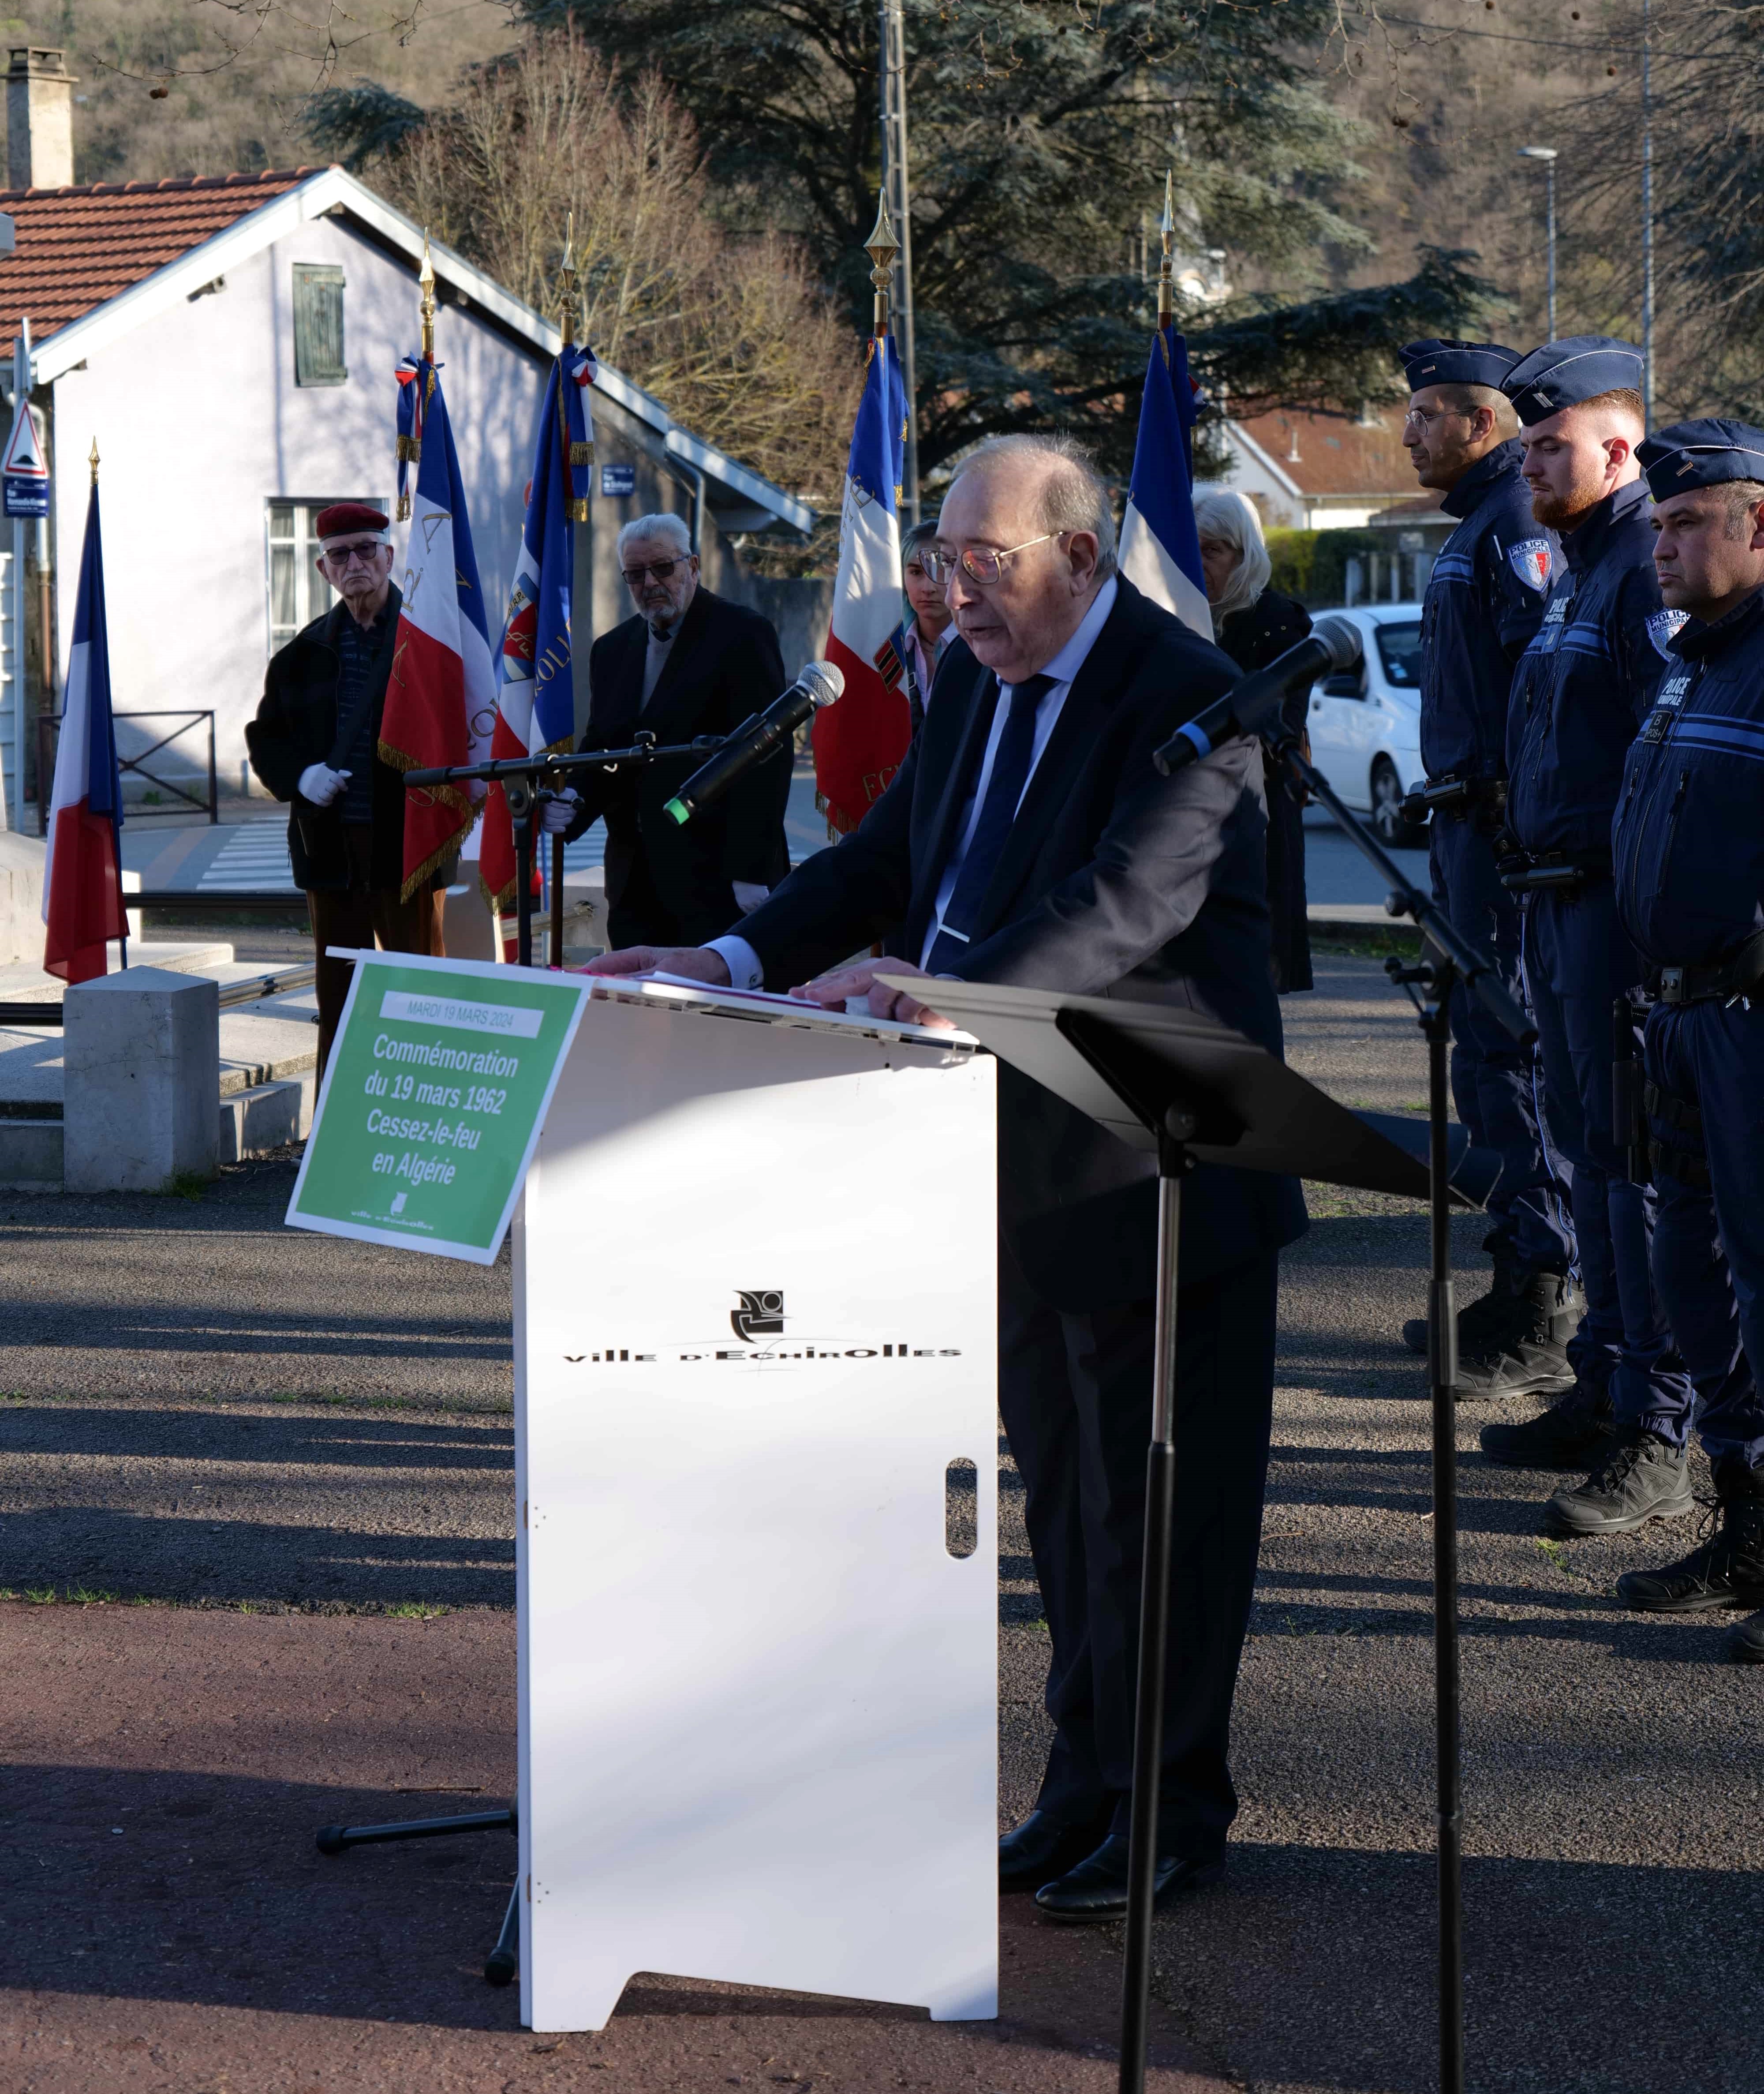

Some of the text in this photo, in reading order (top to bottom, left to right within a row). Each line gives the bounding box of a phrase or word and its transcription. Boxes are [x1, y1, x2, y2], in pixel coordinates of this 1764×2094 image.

[1510, 540, 1548, 554] POLICE
[1512, 547, 1549, 560] MUNICIPALE
[1548, 597, 1570, 614] POLIC
[1654, 715, 1662, 725] B
[407, 1000, 515, 1028] MARDI 19 MARS 2024
[373, 1033, 519, 1078] Commémoration
[364, 1069, 507, 1115] du 19 mars 1962
[366, 1108, 482, 1150] Cessez-le-feu
[372, 1152, 456, 1186] en Algérie
